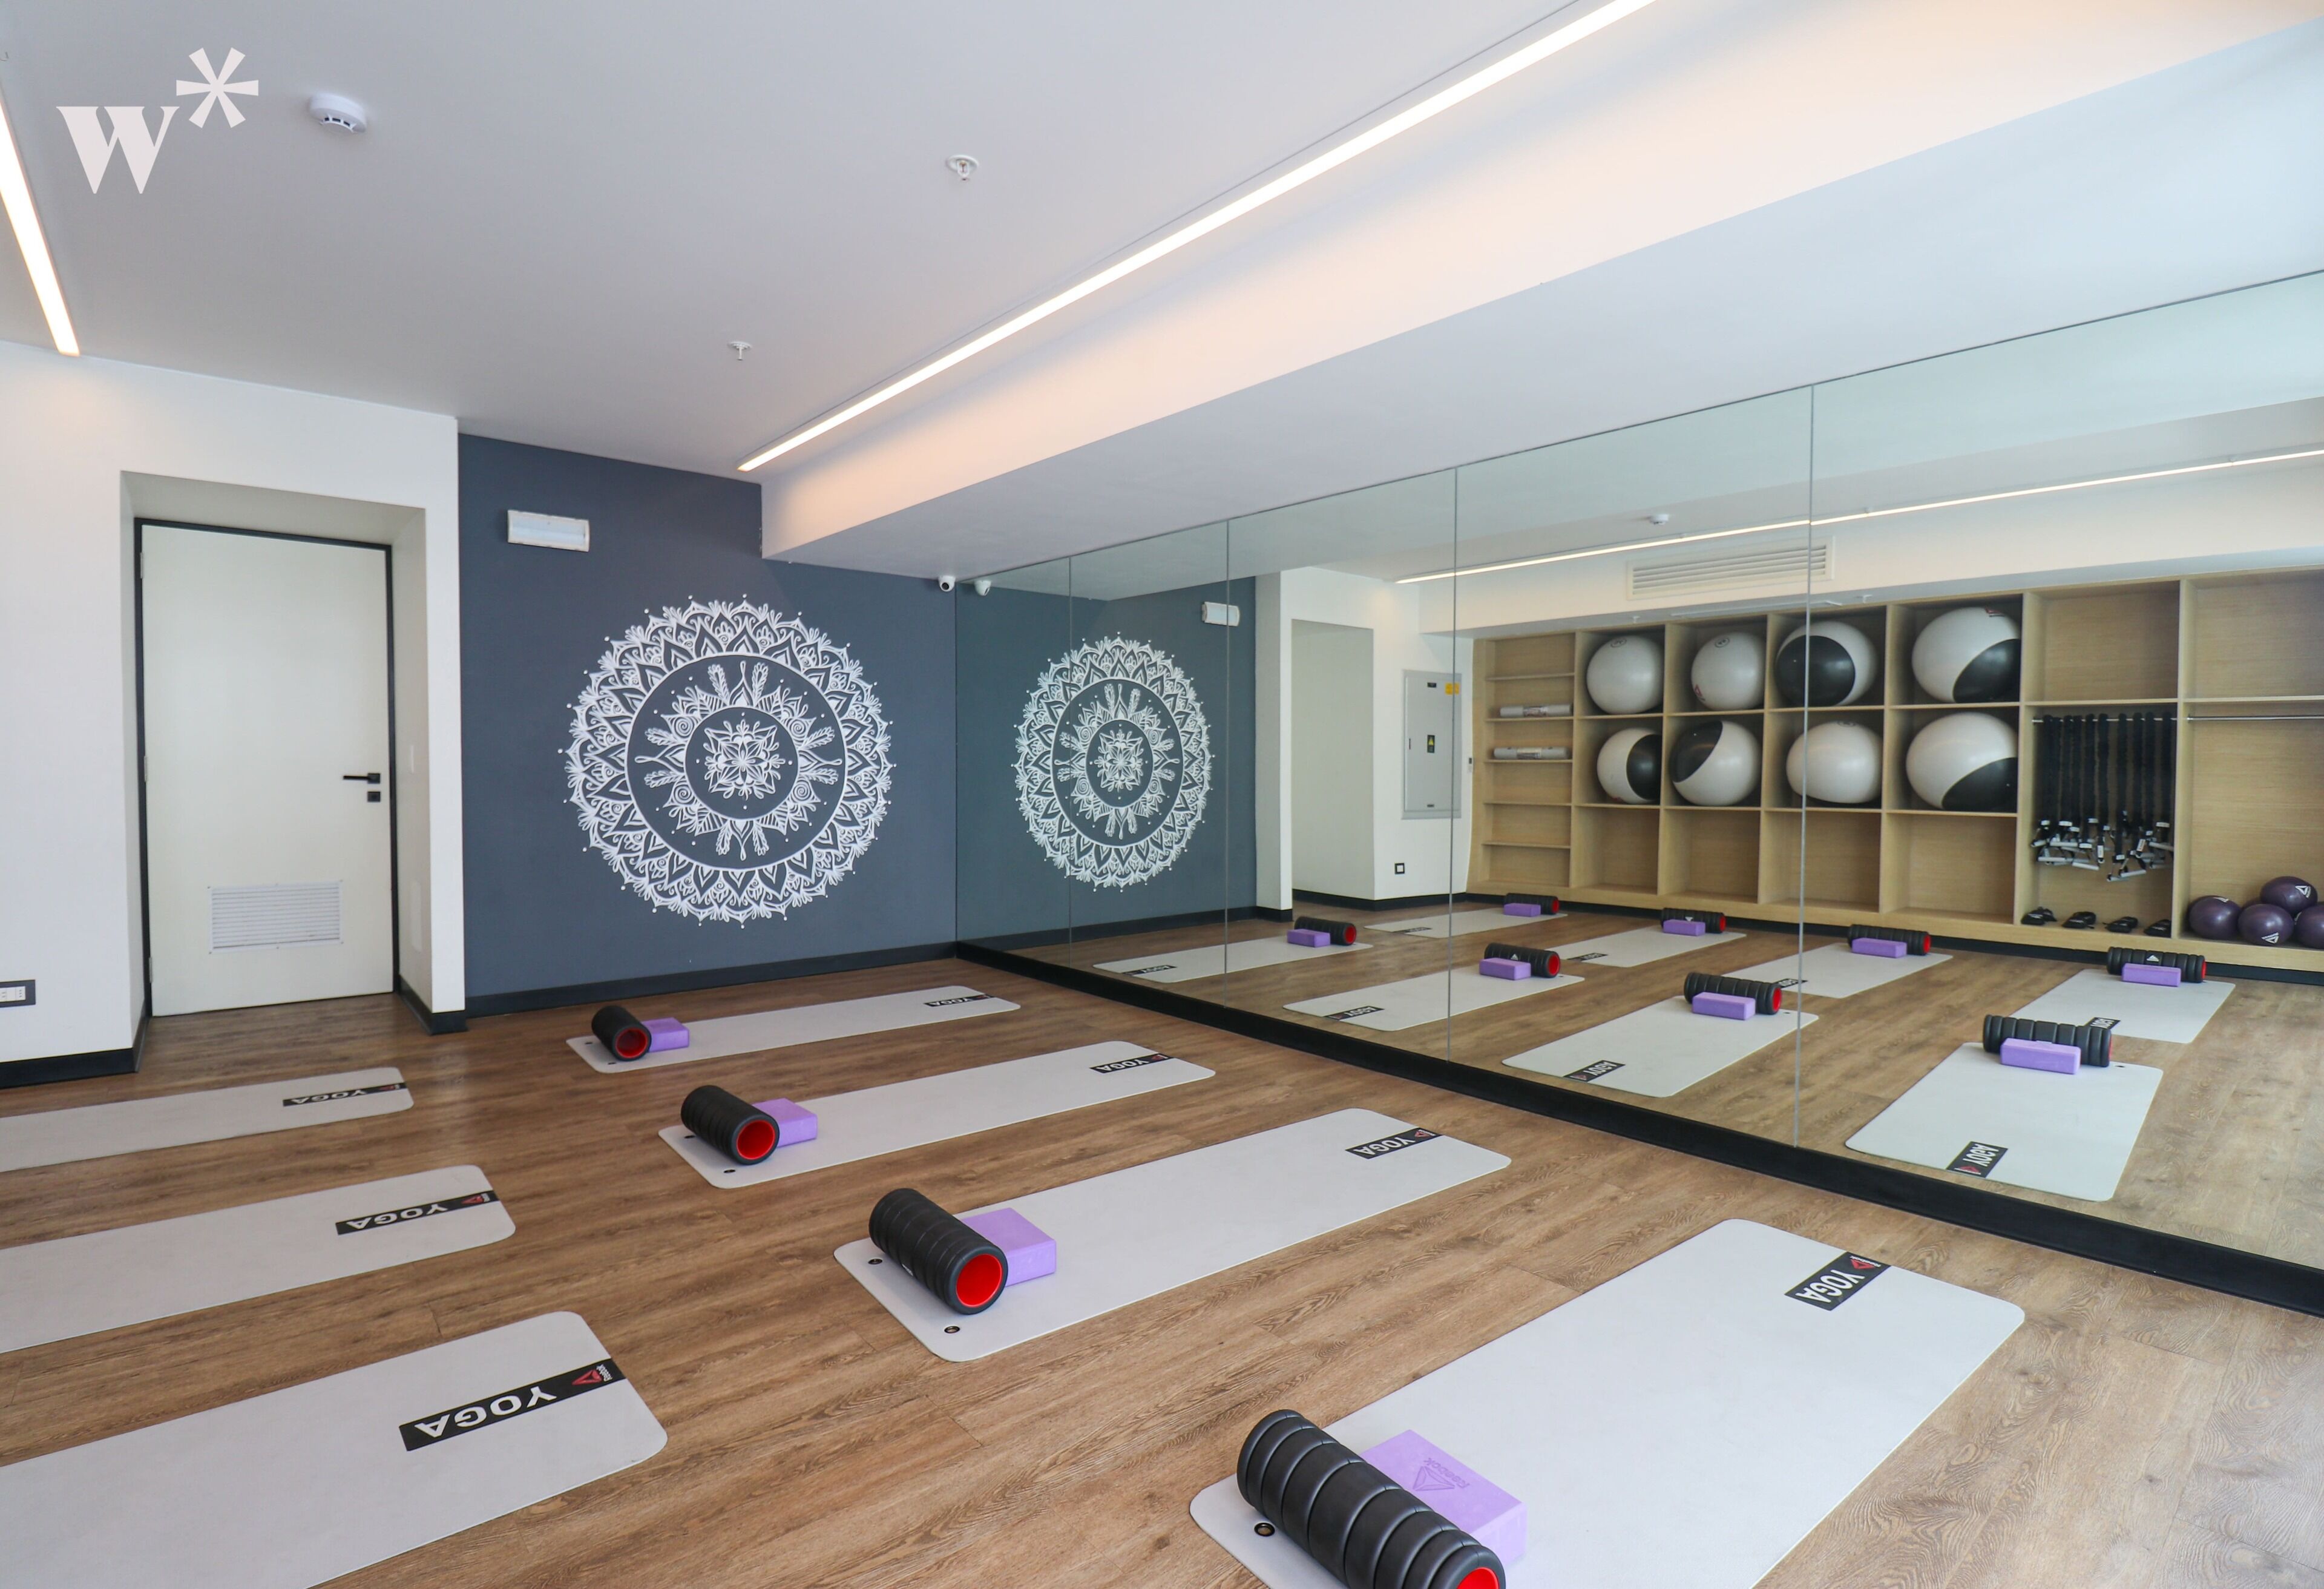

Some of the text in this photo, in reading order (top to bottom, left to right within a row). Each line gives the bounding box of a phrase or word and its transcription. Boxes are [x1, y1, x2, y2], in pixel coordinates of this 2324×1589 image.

[1096, 1059, 1149, 1071] YOGA
[290, 1090, 367, 1104] YOGA
[1353, 1137, 1416, 1156] YOGA
[346, 1203, 448, 1229] YOGA
[1795, 1269, 1865, 1303] YOGA
[414, 1386, 557, 1438] YOGA
[1423, 1457, 1471, 1489] Reebok
